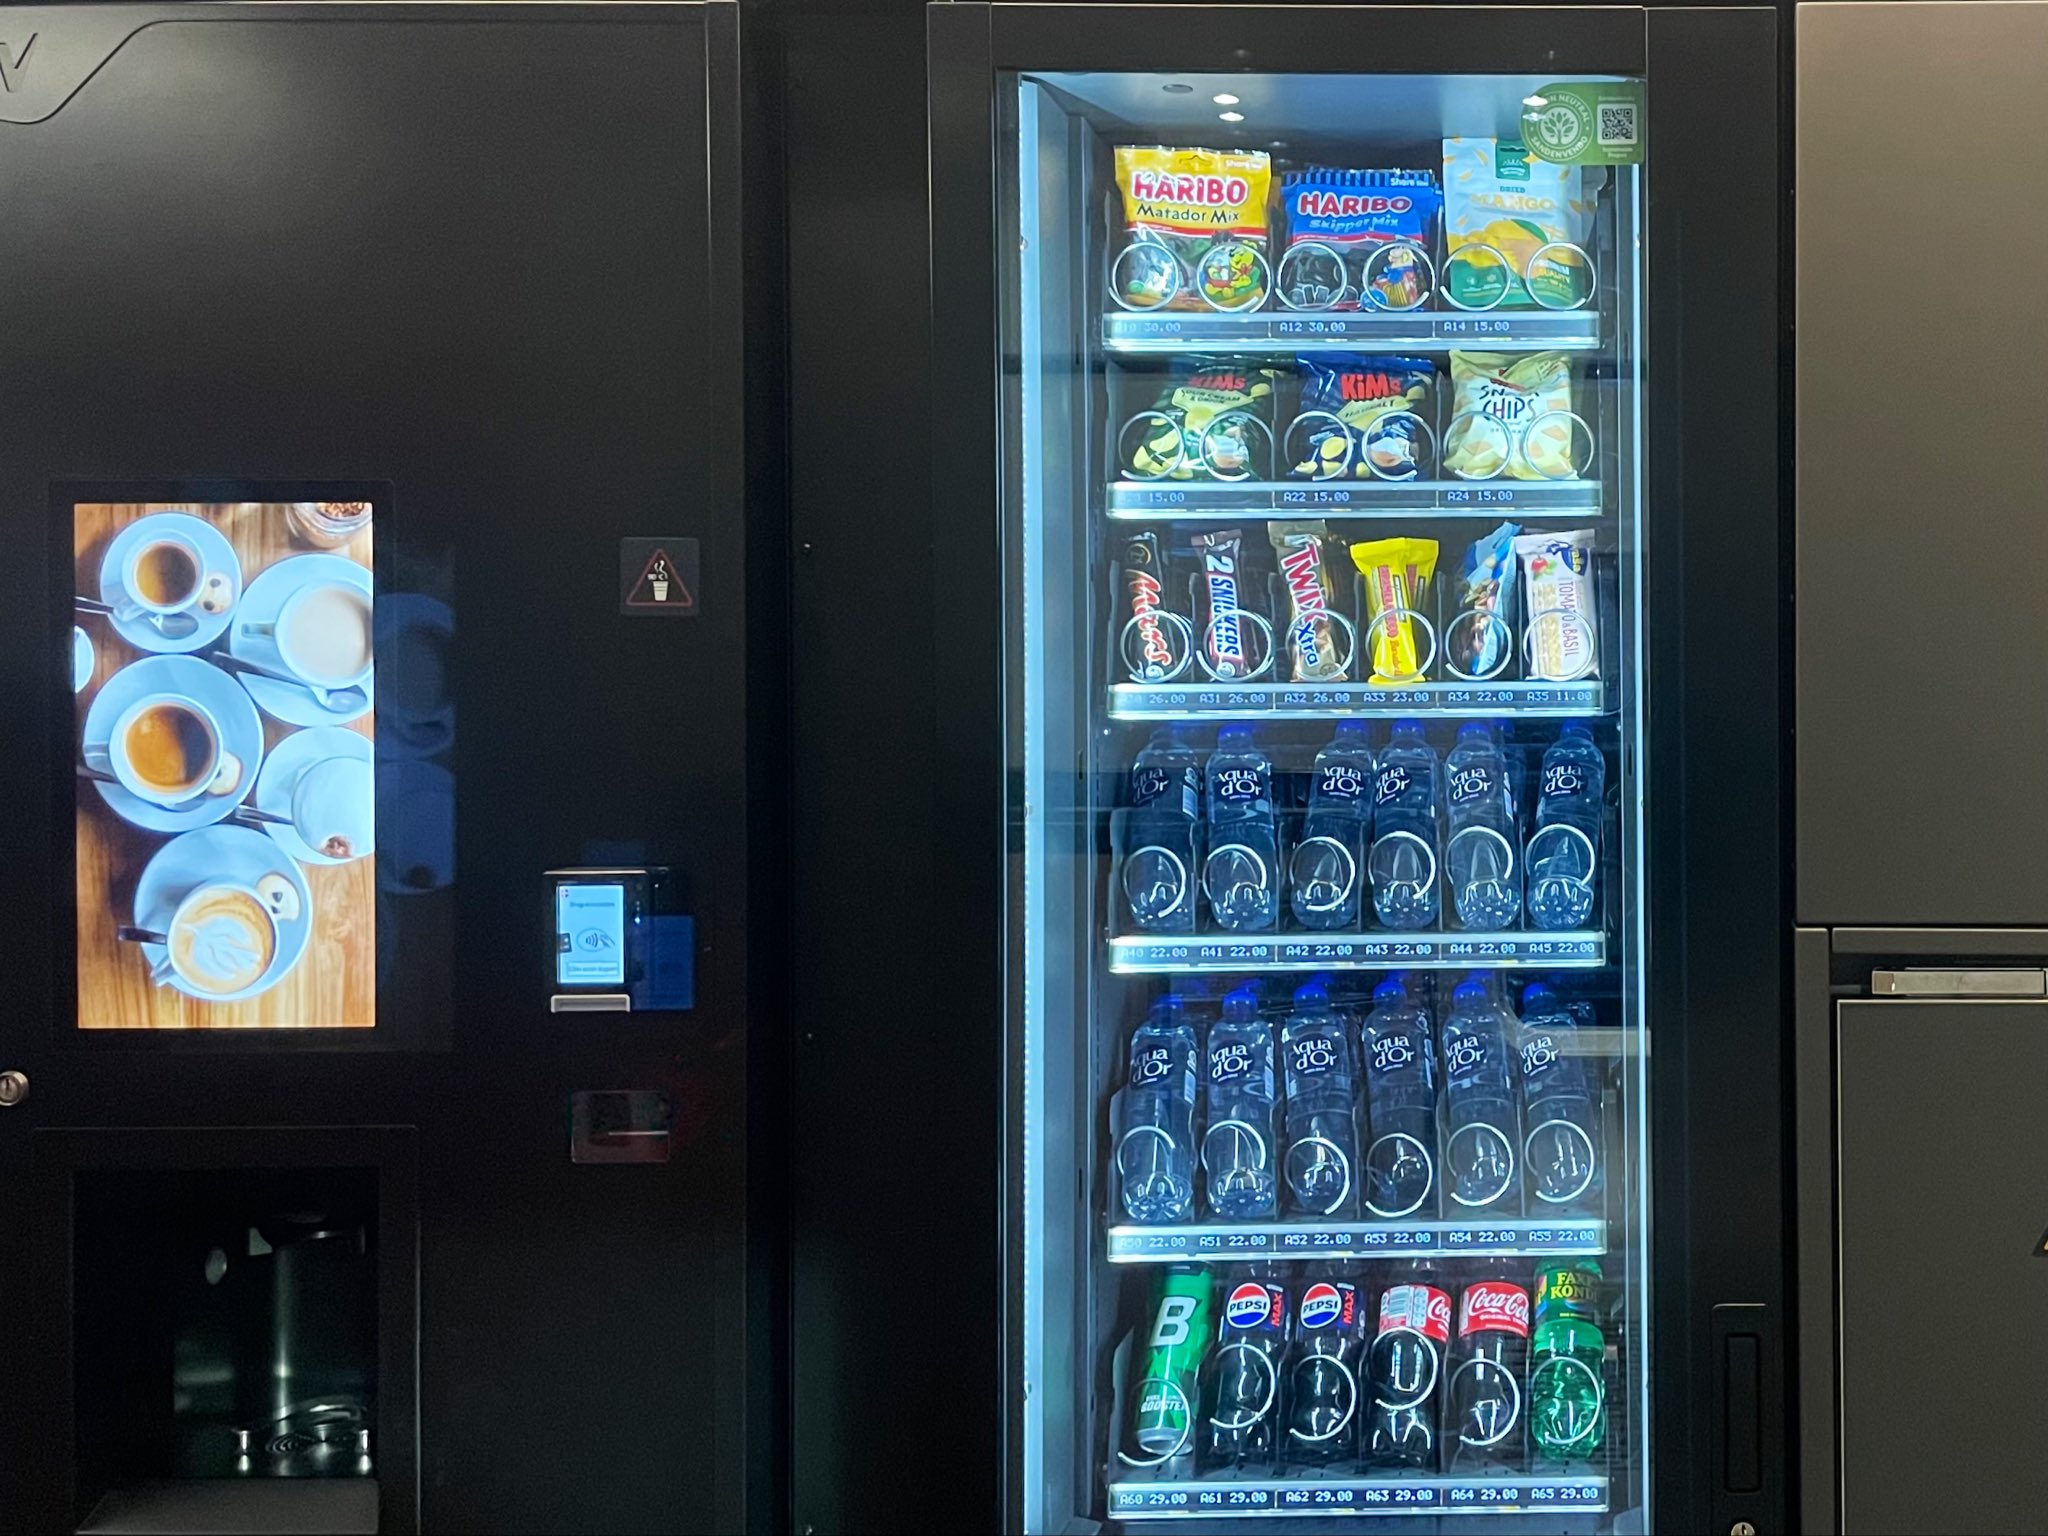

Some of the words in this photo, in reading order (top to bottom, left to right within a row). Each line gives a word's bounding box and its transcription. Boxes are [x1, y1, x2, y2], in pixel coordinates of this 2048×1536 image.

[1558, 94, 1590, 122] NEUTRAL
[1132, 171, 1249, 206] HARIBO
[1298, 190, 1412, 217] HARIBO
[1136, 203, 1207, 221] Matador
[1210, 209, 1240, 224] Mix
[1370, 214, 1399, 232] Mix
[1143, 322, 1182, 333] 30.00
[1279, 322, 1303, 332] A12
[1308, 322, 1346, 332] 30.00
[1443, 321, 1466, 332] A14
[1474, 321, 1510, 332] 15.00
[1482, 396, 1537, 422] CHIPS
[1149, 492, 1185, 503] 15.00
[1283, 491, 1306, 502] A22
[1313, 491, 1350, 502] 15.00
[1447, 491, 1470, 501] A24
[1477, 491, 1513, 501] 15.00
[1205, 553, 1235, 574] 2
[1280, 542, 1328, 623] TWIX
[1294, 620, 1321, 667] Xtra
[1562, 628, 1580, 657] BASIL
[1149, 694, 1186, 704] 26.00
[1200, 694, 1221, 704] A31
[1228, 694, 1265, 704] 26.00
[1284, 693, 1307, 703] A32
[1313, 693, 1350, 703] 26.00
[1363, 692, 1386, 702] A33
[1392, 692, 1429, 702] 23.00
[1448, 691, 1470, 701] A34
[1477, 691, 1514, 701] 22.00
[1526, 691, 1549, 701] A35
[1556, 691, 1592, 701] 11.00
[1150, 947, 1188, 958] 22.00
[1201, 947, 1222, 957] A41
[1230, 946, 1267, 957] 22.00
[1286, 946, 1309, 956] A42
[1315, 945, 1352, 956] 22.00
[1365, 945, 1388, 955] A43
[1394, 944, 1432, 955] 22.00
[1450, 944, 1473, 954] A44
[1479, 943, 1516, 954] 22.00
[1529, 943, 1551, 953] A45
[1558, 943, 1595, 953] 22.00
[1200, 1236, 1221, 1246] A51
[1228, 1235, 1266, 1246] 22.00
[1284, 1235, 1307, 1245] A52
[1314, 1234, 1351, 1245] 22.00
[1364, 1233, 1388, 1244] A53
[1393, 1232, 1431, 1243] 22.00
[1450, 1232, 1472, 1242] A54
[1479, 1231, 1516, 1242] 22.00
[1528, 1231, 1551, 1241] A55
[1558, 1230, 1595, 1241] 22.00
[1148, 1237, 1186, 1247] 22.00
[1229, 1300, 1267, 1312] PEPSI
[1271, 1292, 1283, 1327] MAX
[1303, 1300, 1338, 1313] PEPSI
[1343, 1290, 1355, 1325] MAX
[1150, 1296, 1197, 1347] B
[1120, 1494, 1143, 1505] A60
[1150, 1493, 1187, 1504] 29.00
[1200, 1493, 1222, 1504] A61
[1229, 1492, 1267, 1503] 29.00
[1286, 1491, 1309, 1502] A62
[1315, 1491, 1353, 1502] 29.00
[1366, 1490, 1389, 1501] A63
[1395, 1490, 1433, 1500] 29.00
[1451, 1489, 1474, 1500] A64
[1481, 1488, 1518, 1500] 29.00
[1531, 1488, 1554, 1499] A65
[1561, 1488, 1598, 1499] 29.00
